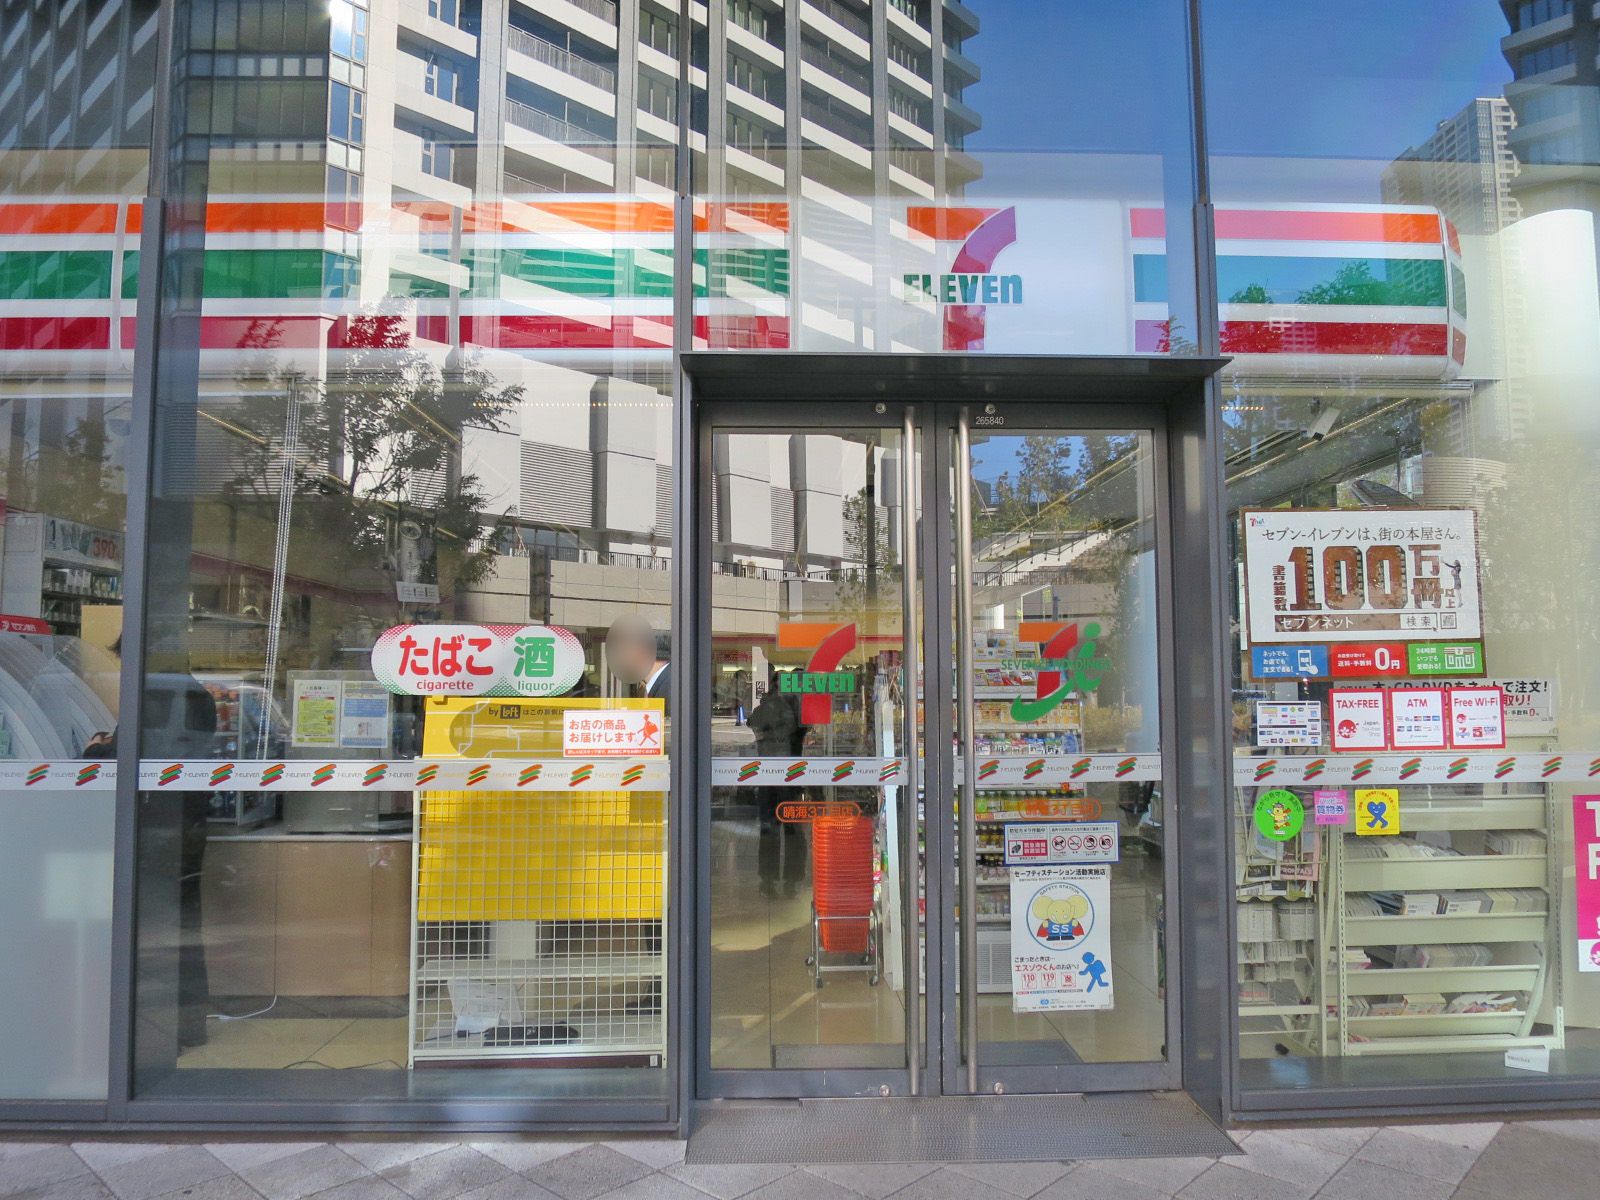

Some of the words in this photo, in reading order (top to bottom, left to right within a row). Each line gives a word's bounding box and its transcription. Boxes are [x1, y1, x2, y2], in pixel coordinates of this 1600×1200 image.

[975, 416, 1004, 425] 265840
[1281, 616, 1354, 631] セブンネット
[1406, 615, 1432, 627] 検索
[398, 634, 495, 677] たばこ
[513, 636, 555, 679] 酒
[416, 680, 475, 692] cigarette
[517, 680, 556, 692] liquor
[1336, 699, 1380, 709] TAX-FREE
[1406, 698, 1428, 708] ATM
[1454, 698, 1473, 707] Free
[1475, 697, 1498, 707] Wi-Fi
[569, 719, 626, 731] お店の商品
[569, 731, 636, 744] お届けします
[1023, 974, 1035, 982] 110
[1042, 973, 1055, 981] 119
